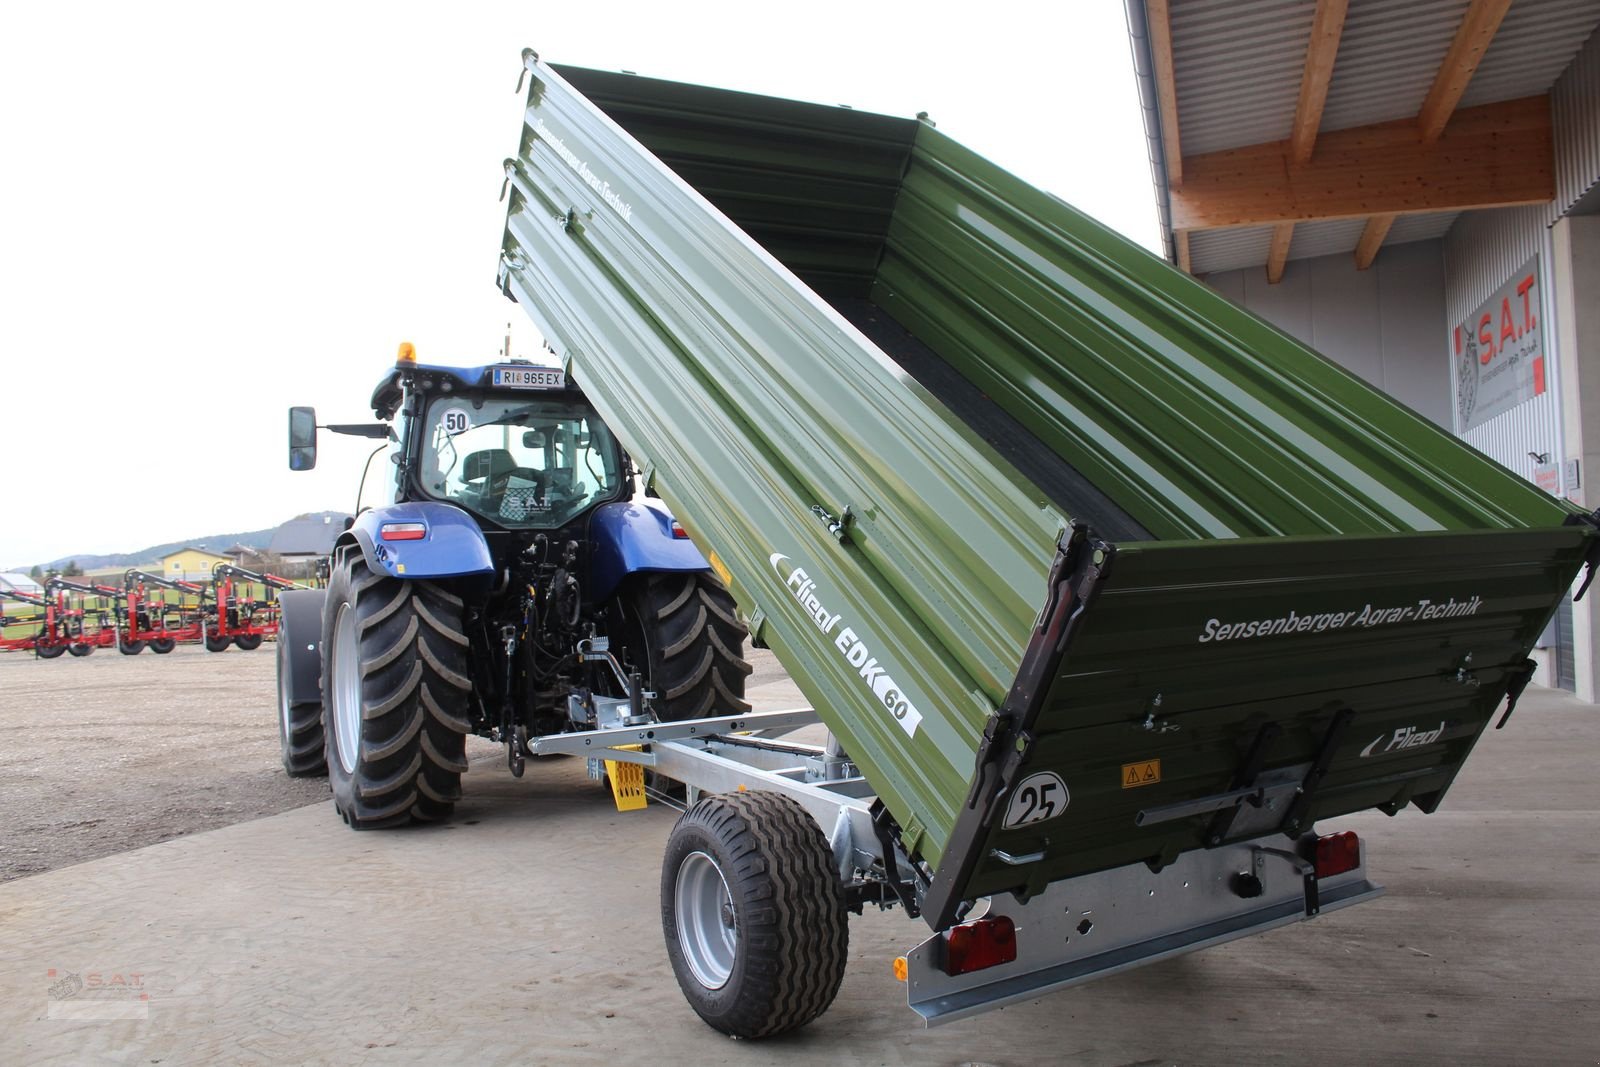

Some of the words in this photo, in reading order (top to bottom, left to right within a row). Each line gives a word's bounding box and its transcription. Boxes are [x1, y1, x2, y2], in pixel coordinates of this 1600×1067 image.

[1478, 274, 1536, 366] S.A.T.
[504, 371, 515, 383] RI
[446, 413, 466, 430] 50
[510, 496, 551, 507] S.A.T.
[1199, 610, 1354, 643] Sensenberger
[1351, 595, 1483, 628] Agrar-Technik
[834, 626, 886, 689] EDK
[884, 688, 909, 720] 60
[1014, 782, 1057, 825] 25
